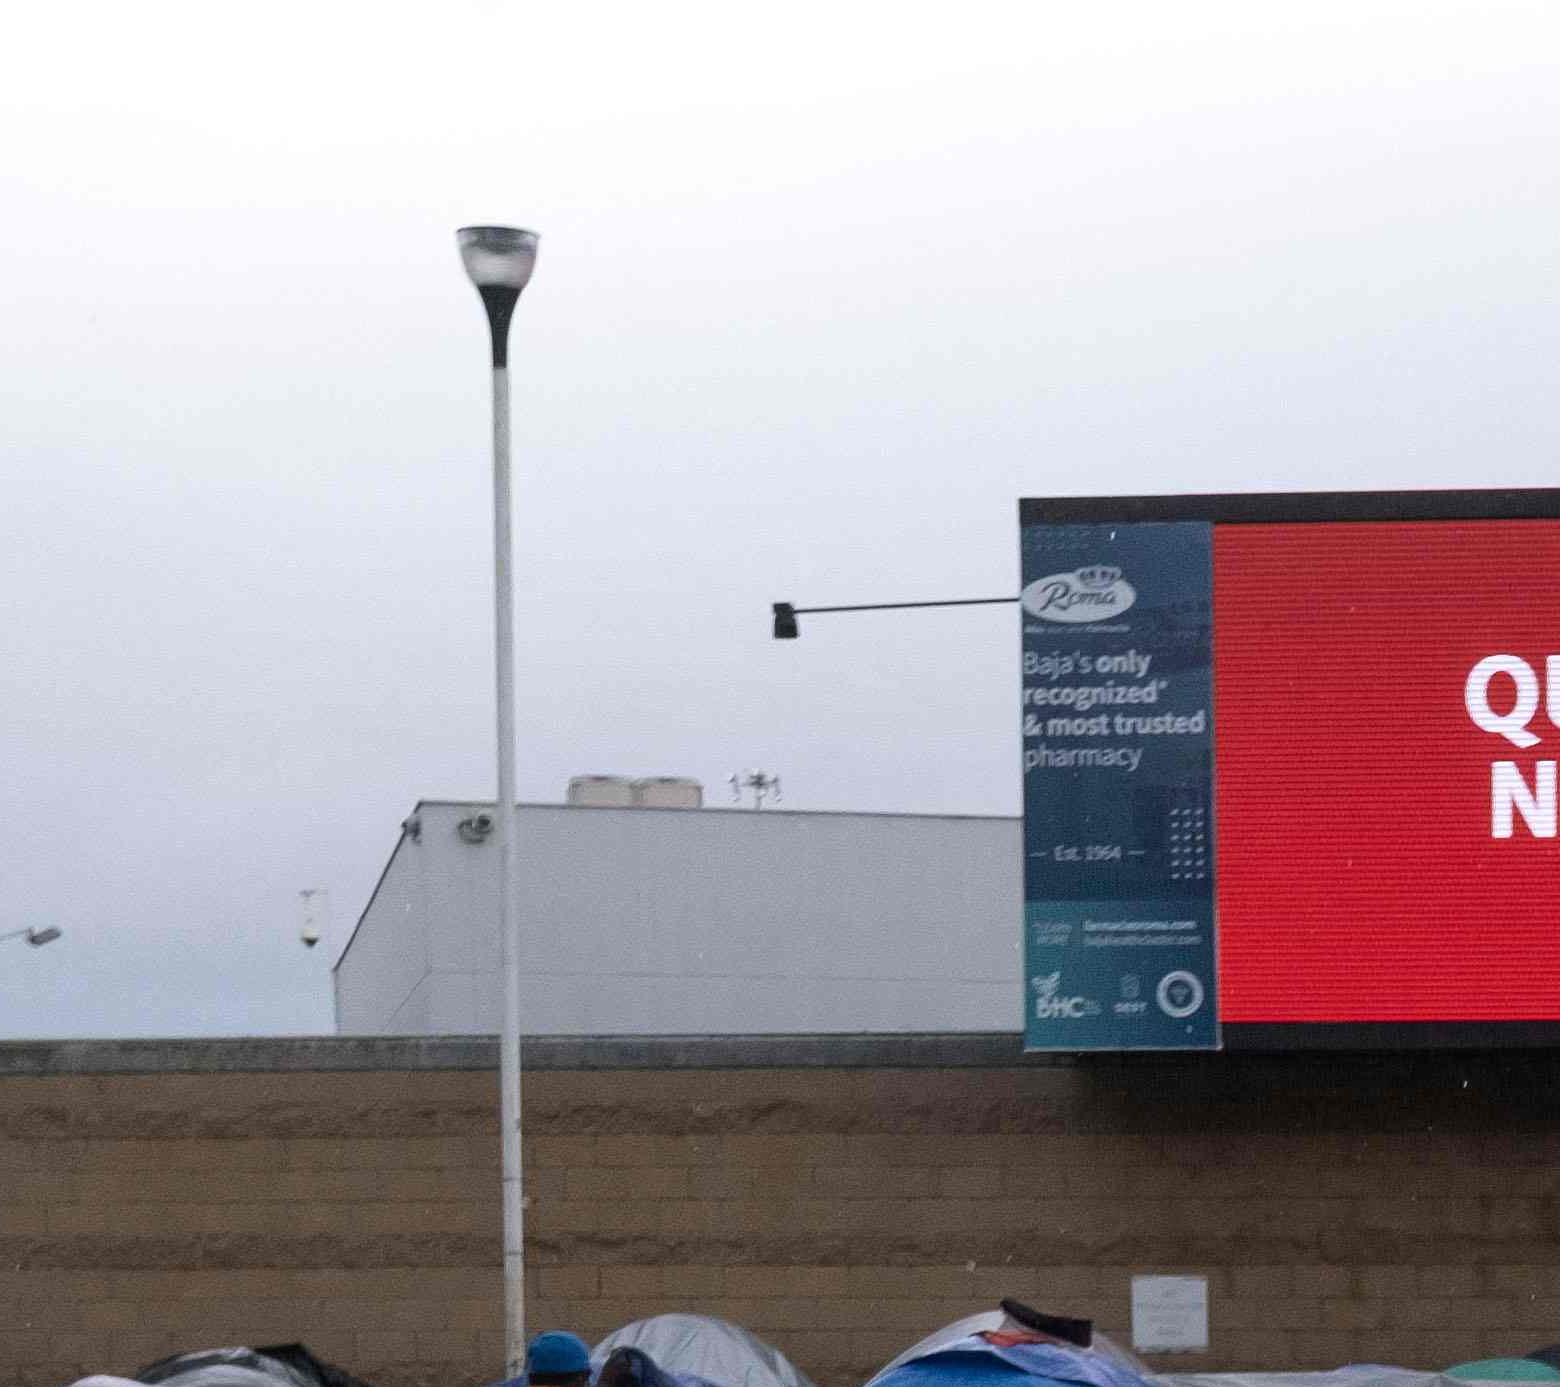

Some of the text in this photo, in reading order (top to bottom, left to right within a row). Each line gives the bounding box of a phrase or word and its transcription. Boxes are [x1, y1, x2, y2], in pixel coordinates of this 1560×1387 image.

[1039, 580, 1117, 612] Roma
[1024, 649, 1152, 681] Baja's only
[1023, 709, 1206, 736] & most trusted
[1024, 743, 1143, 772] pharmacy
